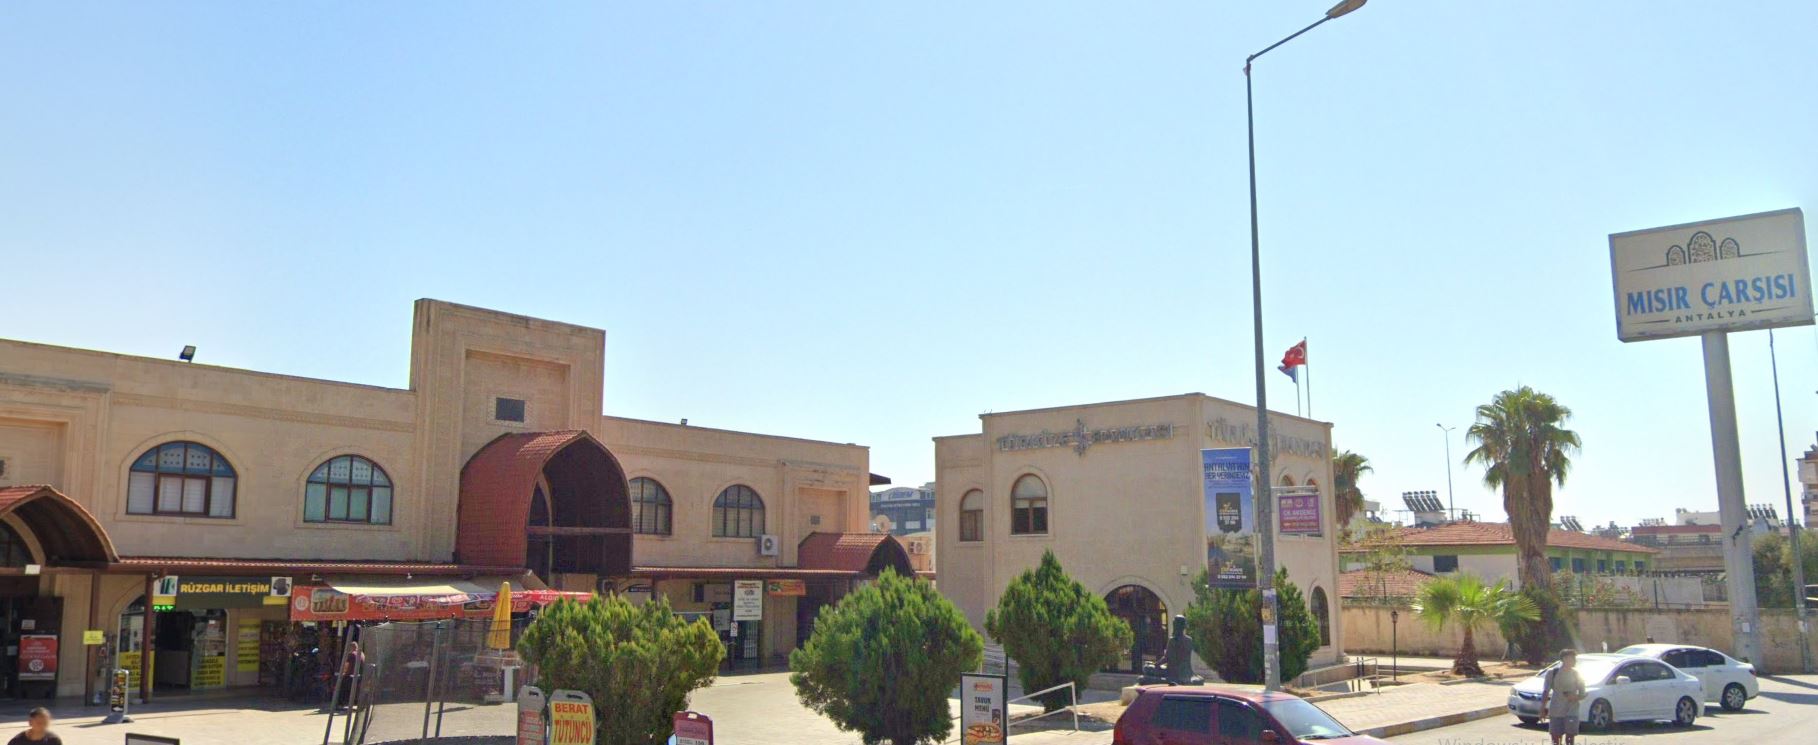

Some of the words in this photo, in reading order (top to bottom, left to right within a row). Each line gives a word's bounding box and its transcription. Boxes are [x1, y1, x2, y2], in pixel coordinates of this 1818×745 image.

[1627, 286, 1690, 316] MISIR
[1700, 273, 1797, 309] ÇARŞISI
[1675, 308, 1747, 324] ANTALYA
[180, 582, 224, 593] RÜZGAR
[225, 582, 270, 595] İLETİŞİM
[554, 703, 589, 714] BERAT
[553, 715, 592, 744] TÜTÜNCÜ
